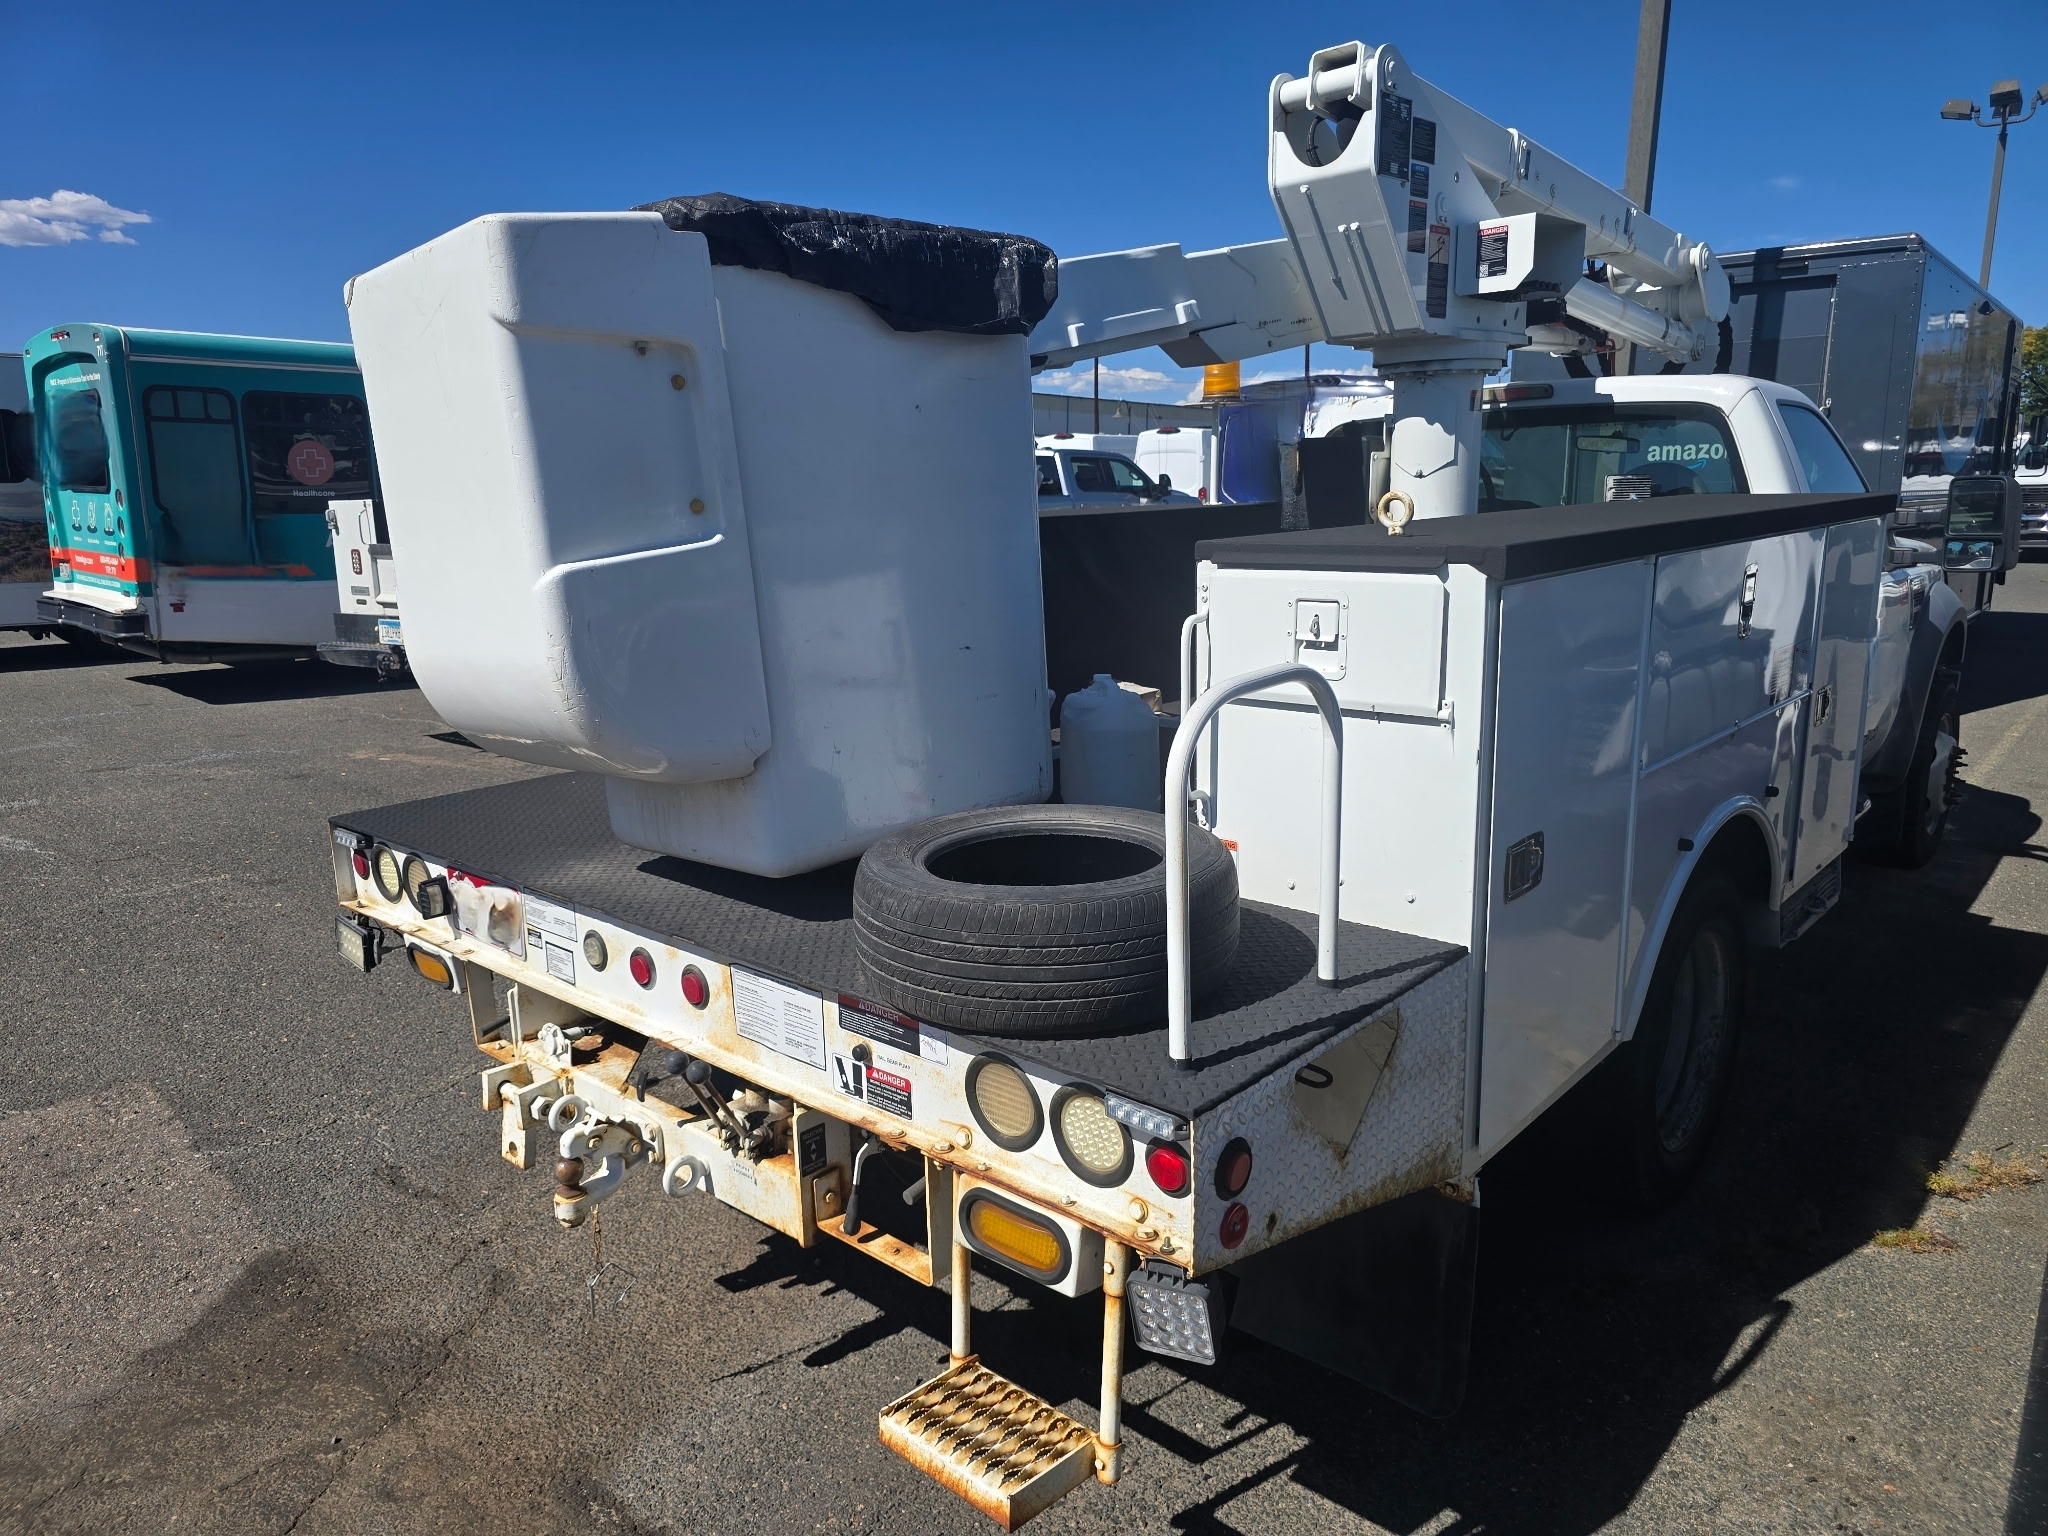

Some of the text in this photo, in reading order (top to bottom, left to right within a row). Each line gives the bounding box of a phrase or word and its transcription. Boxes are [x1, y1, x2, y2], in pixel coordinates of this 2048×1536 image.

[1484, 226, 1508, 235] DANGER
[865, 1002, 899, 1021] DANGER
[878, 1072, 905, 1089] DANGER
